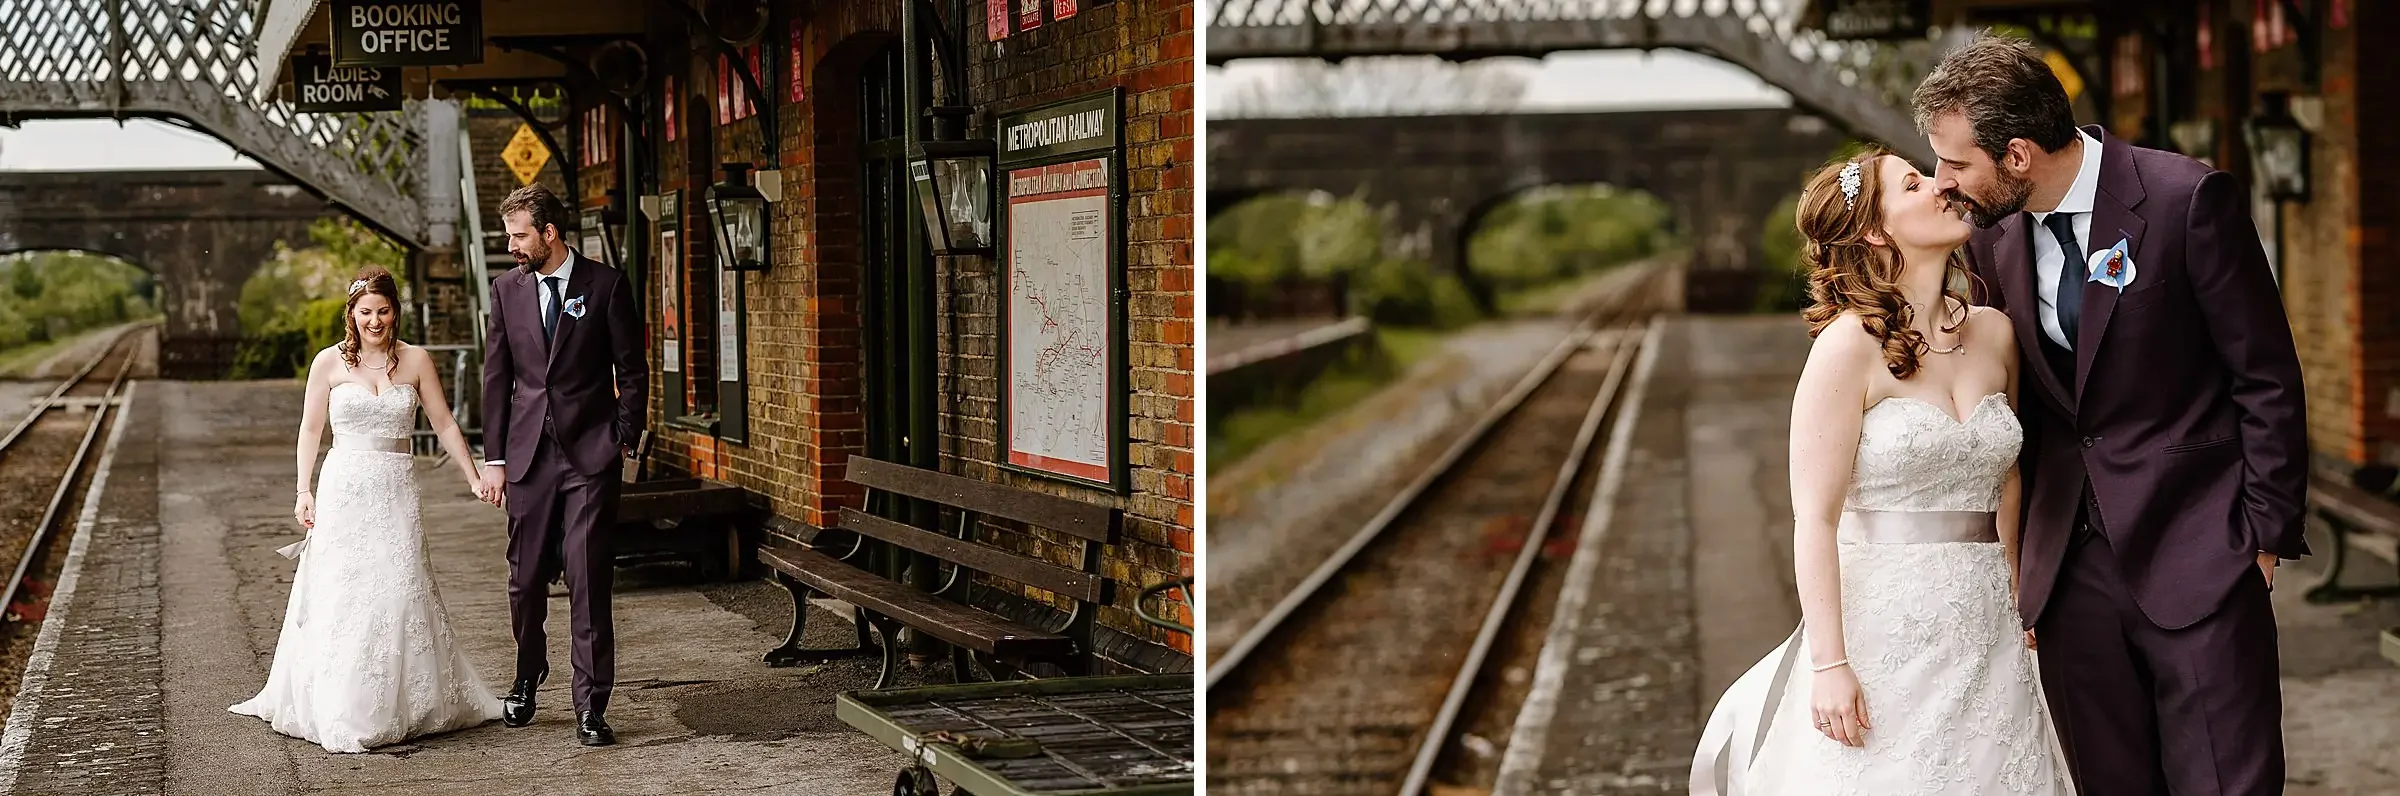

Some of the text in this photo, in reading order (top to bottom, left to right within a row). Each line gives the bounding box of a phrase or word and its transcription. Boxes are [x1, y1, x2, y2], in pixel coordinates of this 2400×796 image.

[351, 3, 461, 28] BOOKING
[361, 29, 450, 54] OFFICE
[314, 65, 382, 84] LADIES
[303, 84, 364, 103] ROOM
[1007, 108, 1105, 152] METROPOLITAN RAILWAY
